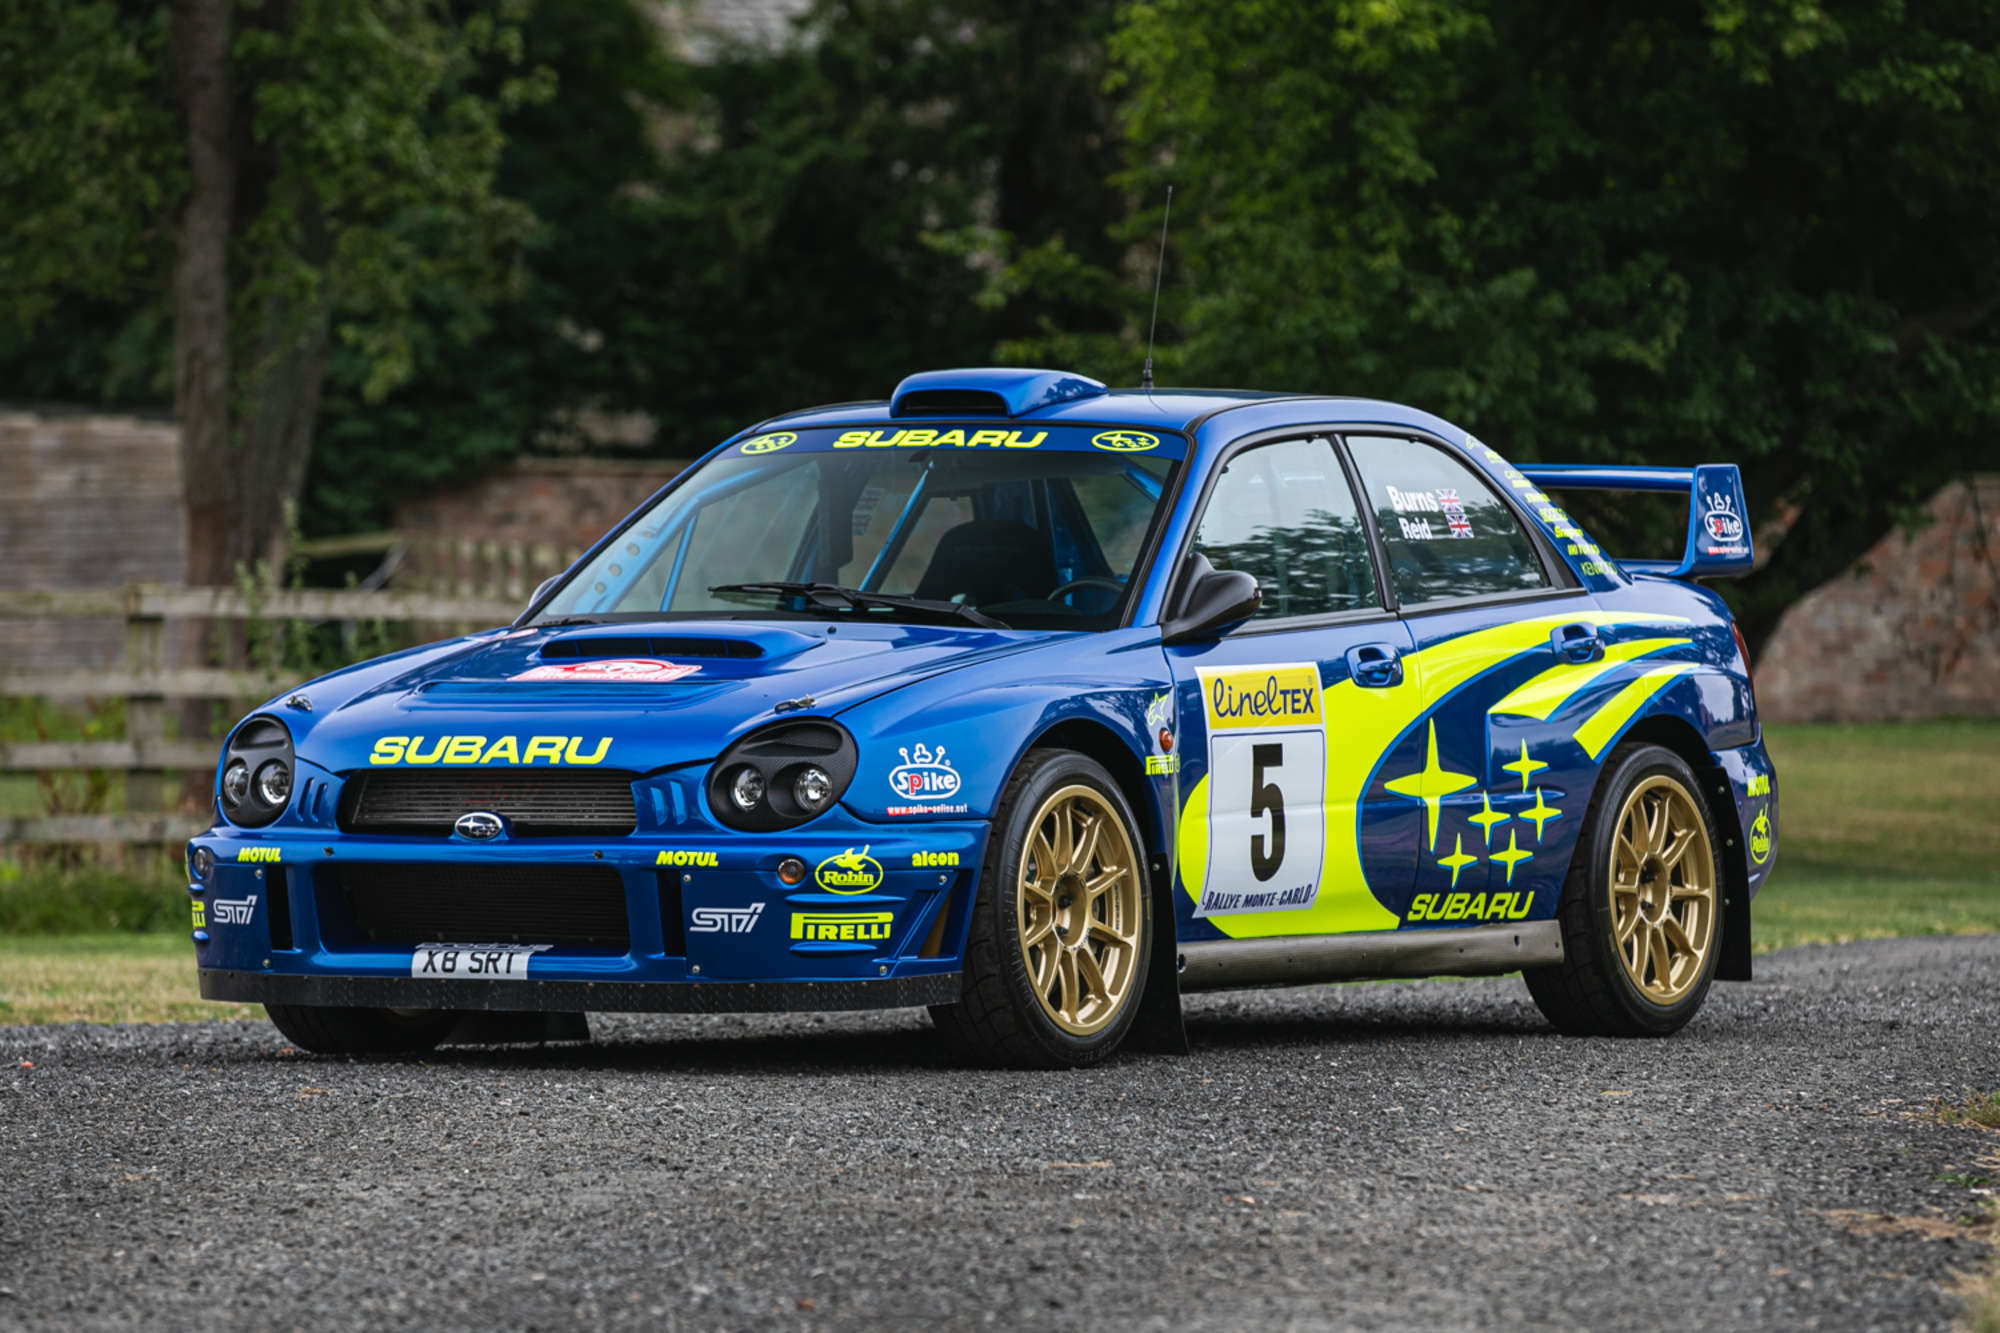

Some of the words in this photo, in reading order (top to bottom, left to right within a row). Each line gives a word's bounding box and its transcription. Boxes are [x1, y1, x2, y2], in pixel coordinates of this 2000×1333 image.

[832, 429, 1048, 449] SUBARU
[1385, 486, 1439, 512] Burns
[1398, 517, 1433, 540] Reid
[1708, 516, 1741, 536] Spike
[369, 735, 614, 765] SUBARU
[897, 771, 956, 795] Spike
[1250, 743, 1286, 882] 5
[237, 847, 281, 863] MOTUL
[656, 850, 719, 867] MOTUL
[911, 851, 959, 866] alcon
[823, 870, 875, 886] Robin
[1204, 890, 1241, 911] RALLYE
[1241, 883, 1313, 910] MONTE-CARLO
[1407, 890, 1535, 921] SUBARU
[790, 912, 894, 940] PIRELLI
[422, 951, 459, 973] X8
[468, 951, 522, 974] SRT
